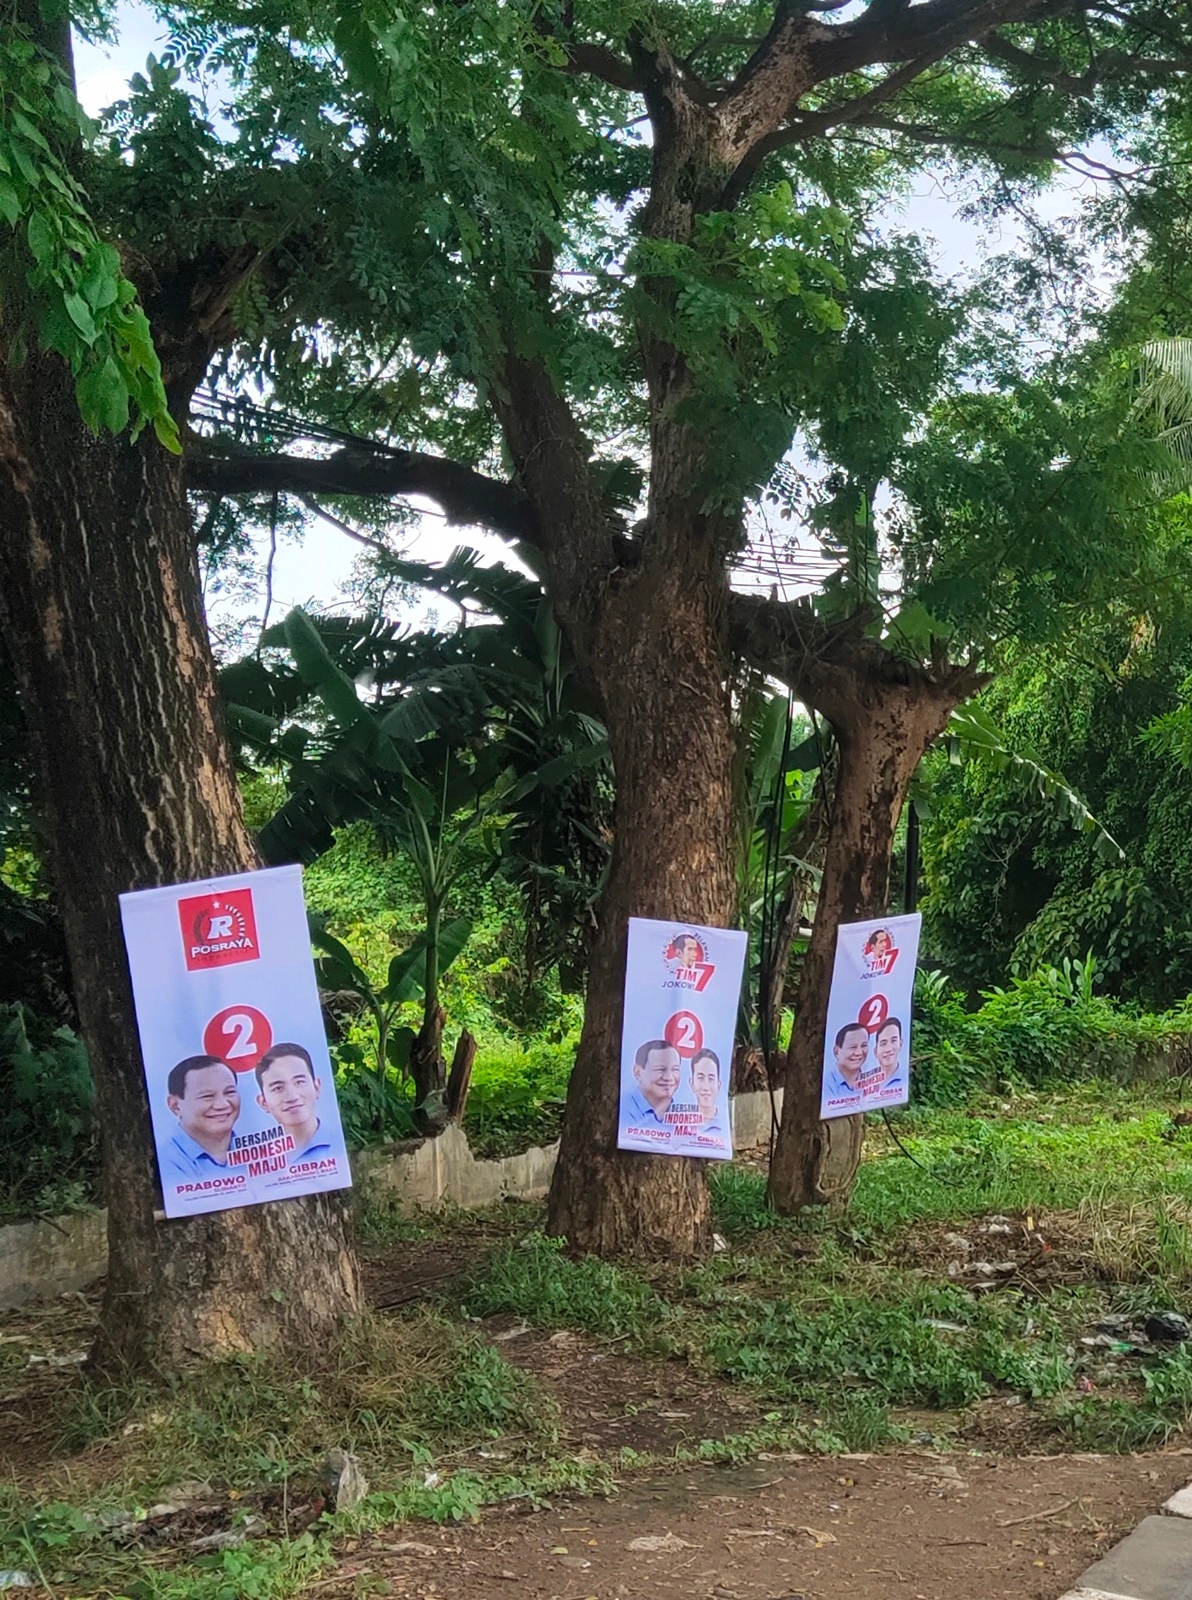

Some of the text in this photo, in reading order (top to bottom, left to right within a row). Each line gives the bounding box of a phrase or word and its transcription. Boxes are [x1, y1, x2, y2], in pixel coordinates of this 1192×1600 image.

[207, 915, 233, 940] R
[191, 937, 253, 958] POSRAYA
[871, 957, 886, 971] TIM
[884, 948, 899, 975] 7
[676, 962, 716, 992] TIM 7
[867, 998, 882, 1027] 2
[222, 1013, 258, 1060] 2
[677, 1016, 696, 1049] 2
[671, 1103, 700, 1113] BERSAMA
[827, 1096, 861, 1106] PRABOWO
[664, 1113, 703, 1124] INDONESIA
[234, 1125, 284, 1149] BERSAMA
[627, 1127, 671, 1139] PRABOWO
[674, 1125, 697, 1136] MAJU
[228, 1136, 294, 1167] INDONESIA
[249, 1155, 286, 1178] MAJU
[289, 1158, 336, 1174] GIBRAN
[176, 1175, 245, 1194] PRABOWO
